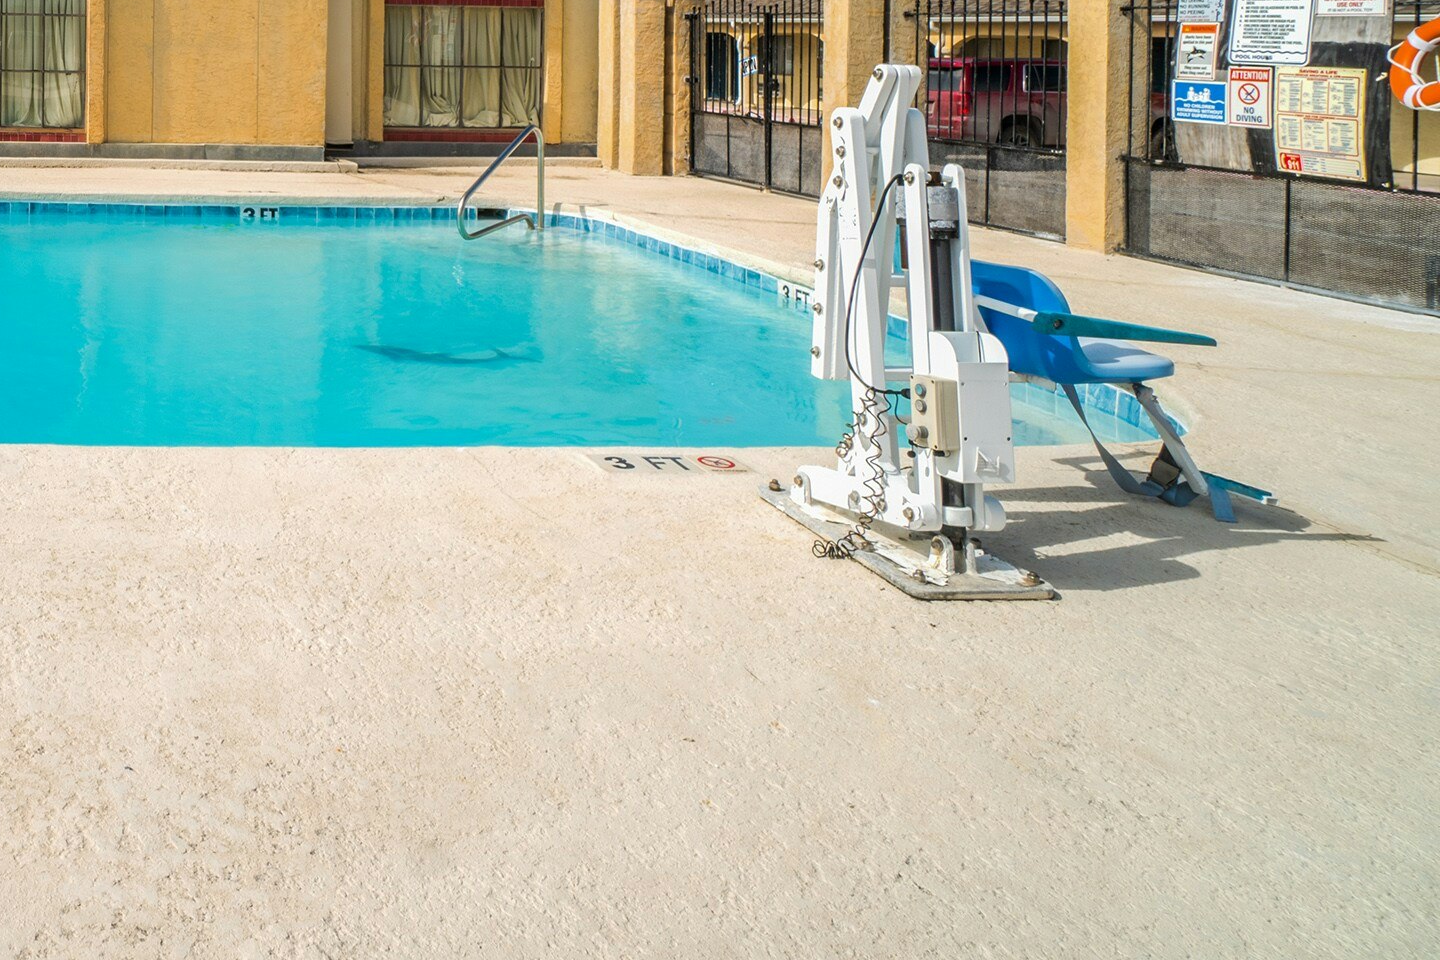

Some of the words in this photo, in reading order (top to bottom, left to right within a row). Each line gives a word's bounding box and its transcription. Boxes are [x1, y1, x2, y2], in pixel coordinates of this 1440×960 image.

[1232, 71, 1268, 80] ATTENTION
[1236, 115, 1262, 123] DIVING
[1287, 160, 1299, 170] 911
[243, 208, 255, 217] 3
[260, 208, 278, 218] FT
[783, 285, 789, 298] 3
[796, 289, 809, 304] FT
[603, 456, 636, 469] 3
[641, 456, 690, 471] FT
